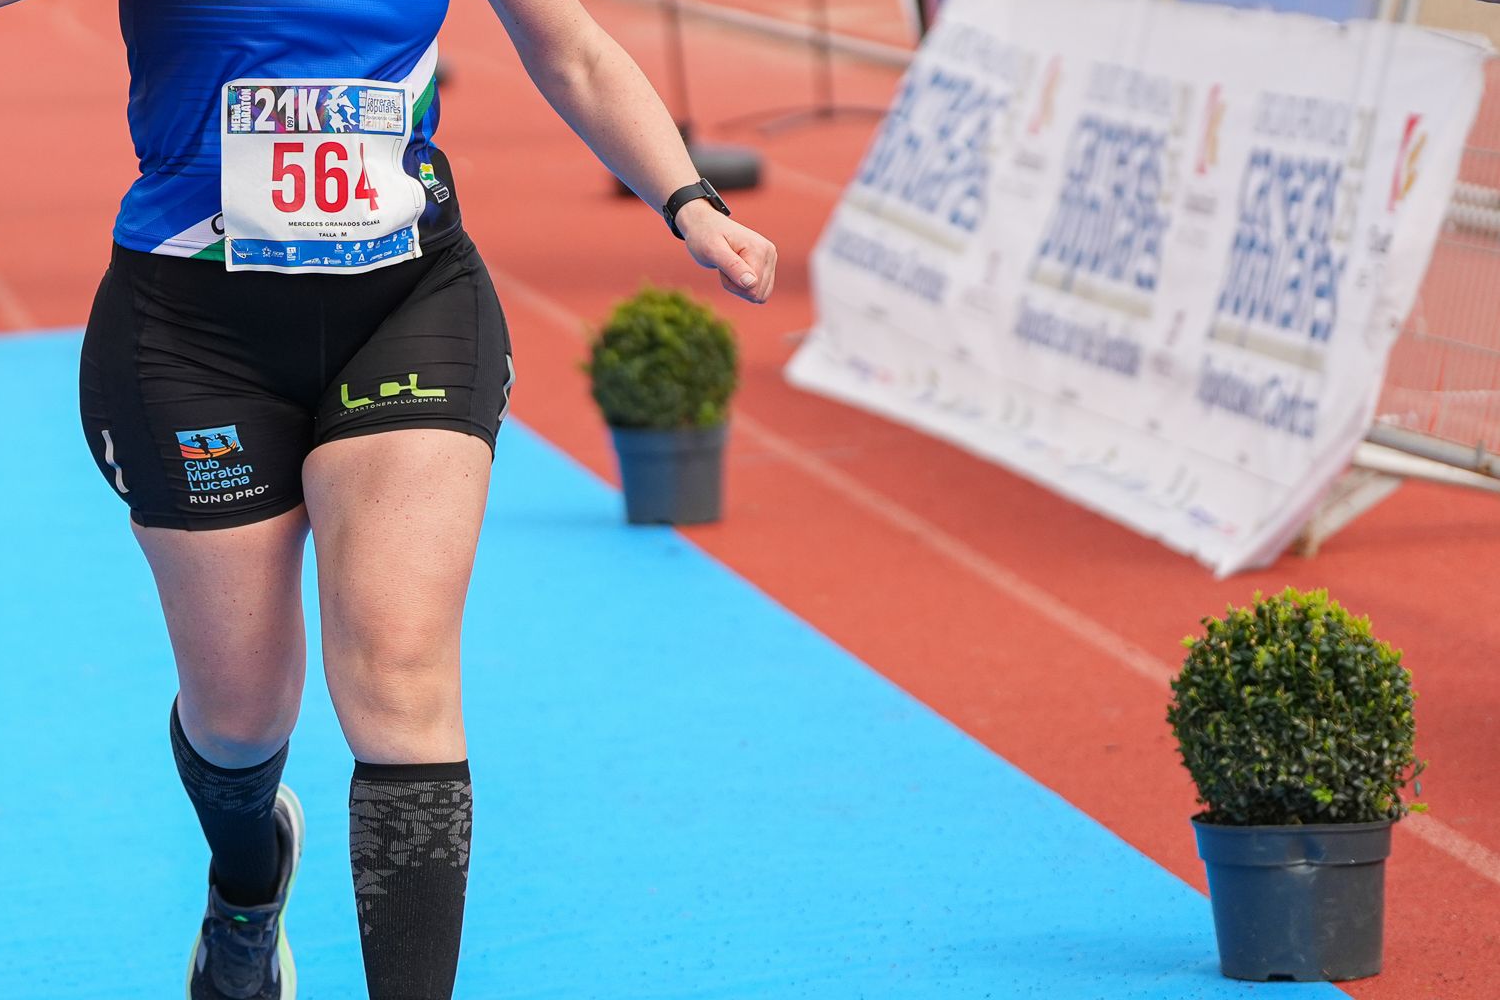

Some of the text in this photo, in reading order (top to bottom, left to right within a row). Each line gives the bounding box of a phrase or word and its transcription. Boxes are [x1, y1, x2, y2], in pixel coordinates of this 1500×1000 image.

[254, 87, 322, 131] 21K
[271, 141, 380, 214] 564
[349, 400, 398, 414] CARTONERA
[184, 459, 220, 471] Club
[186, 464, 254, 482] Maratón
[189, 475, 250, 491] Lucena
